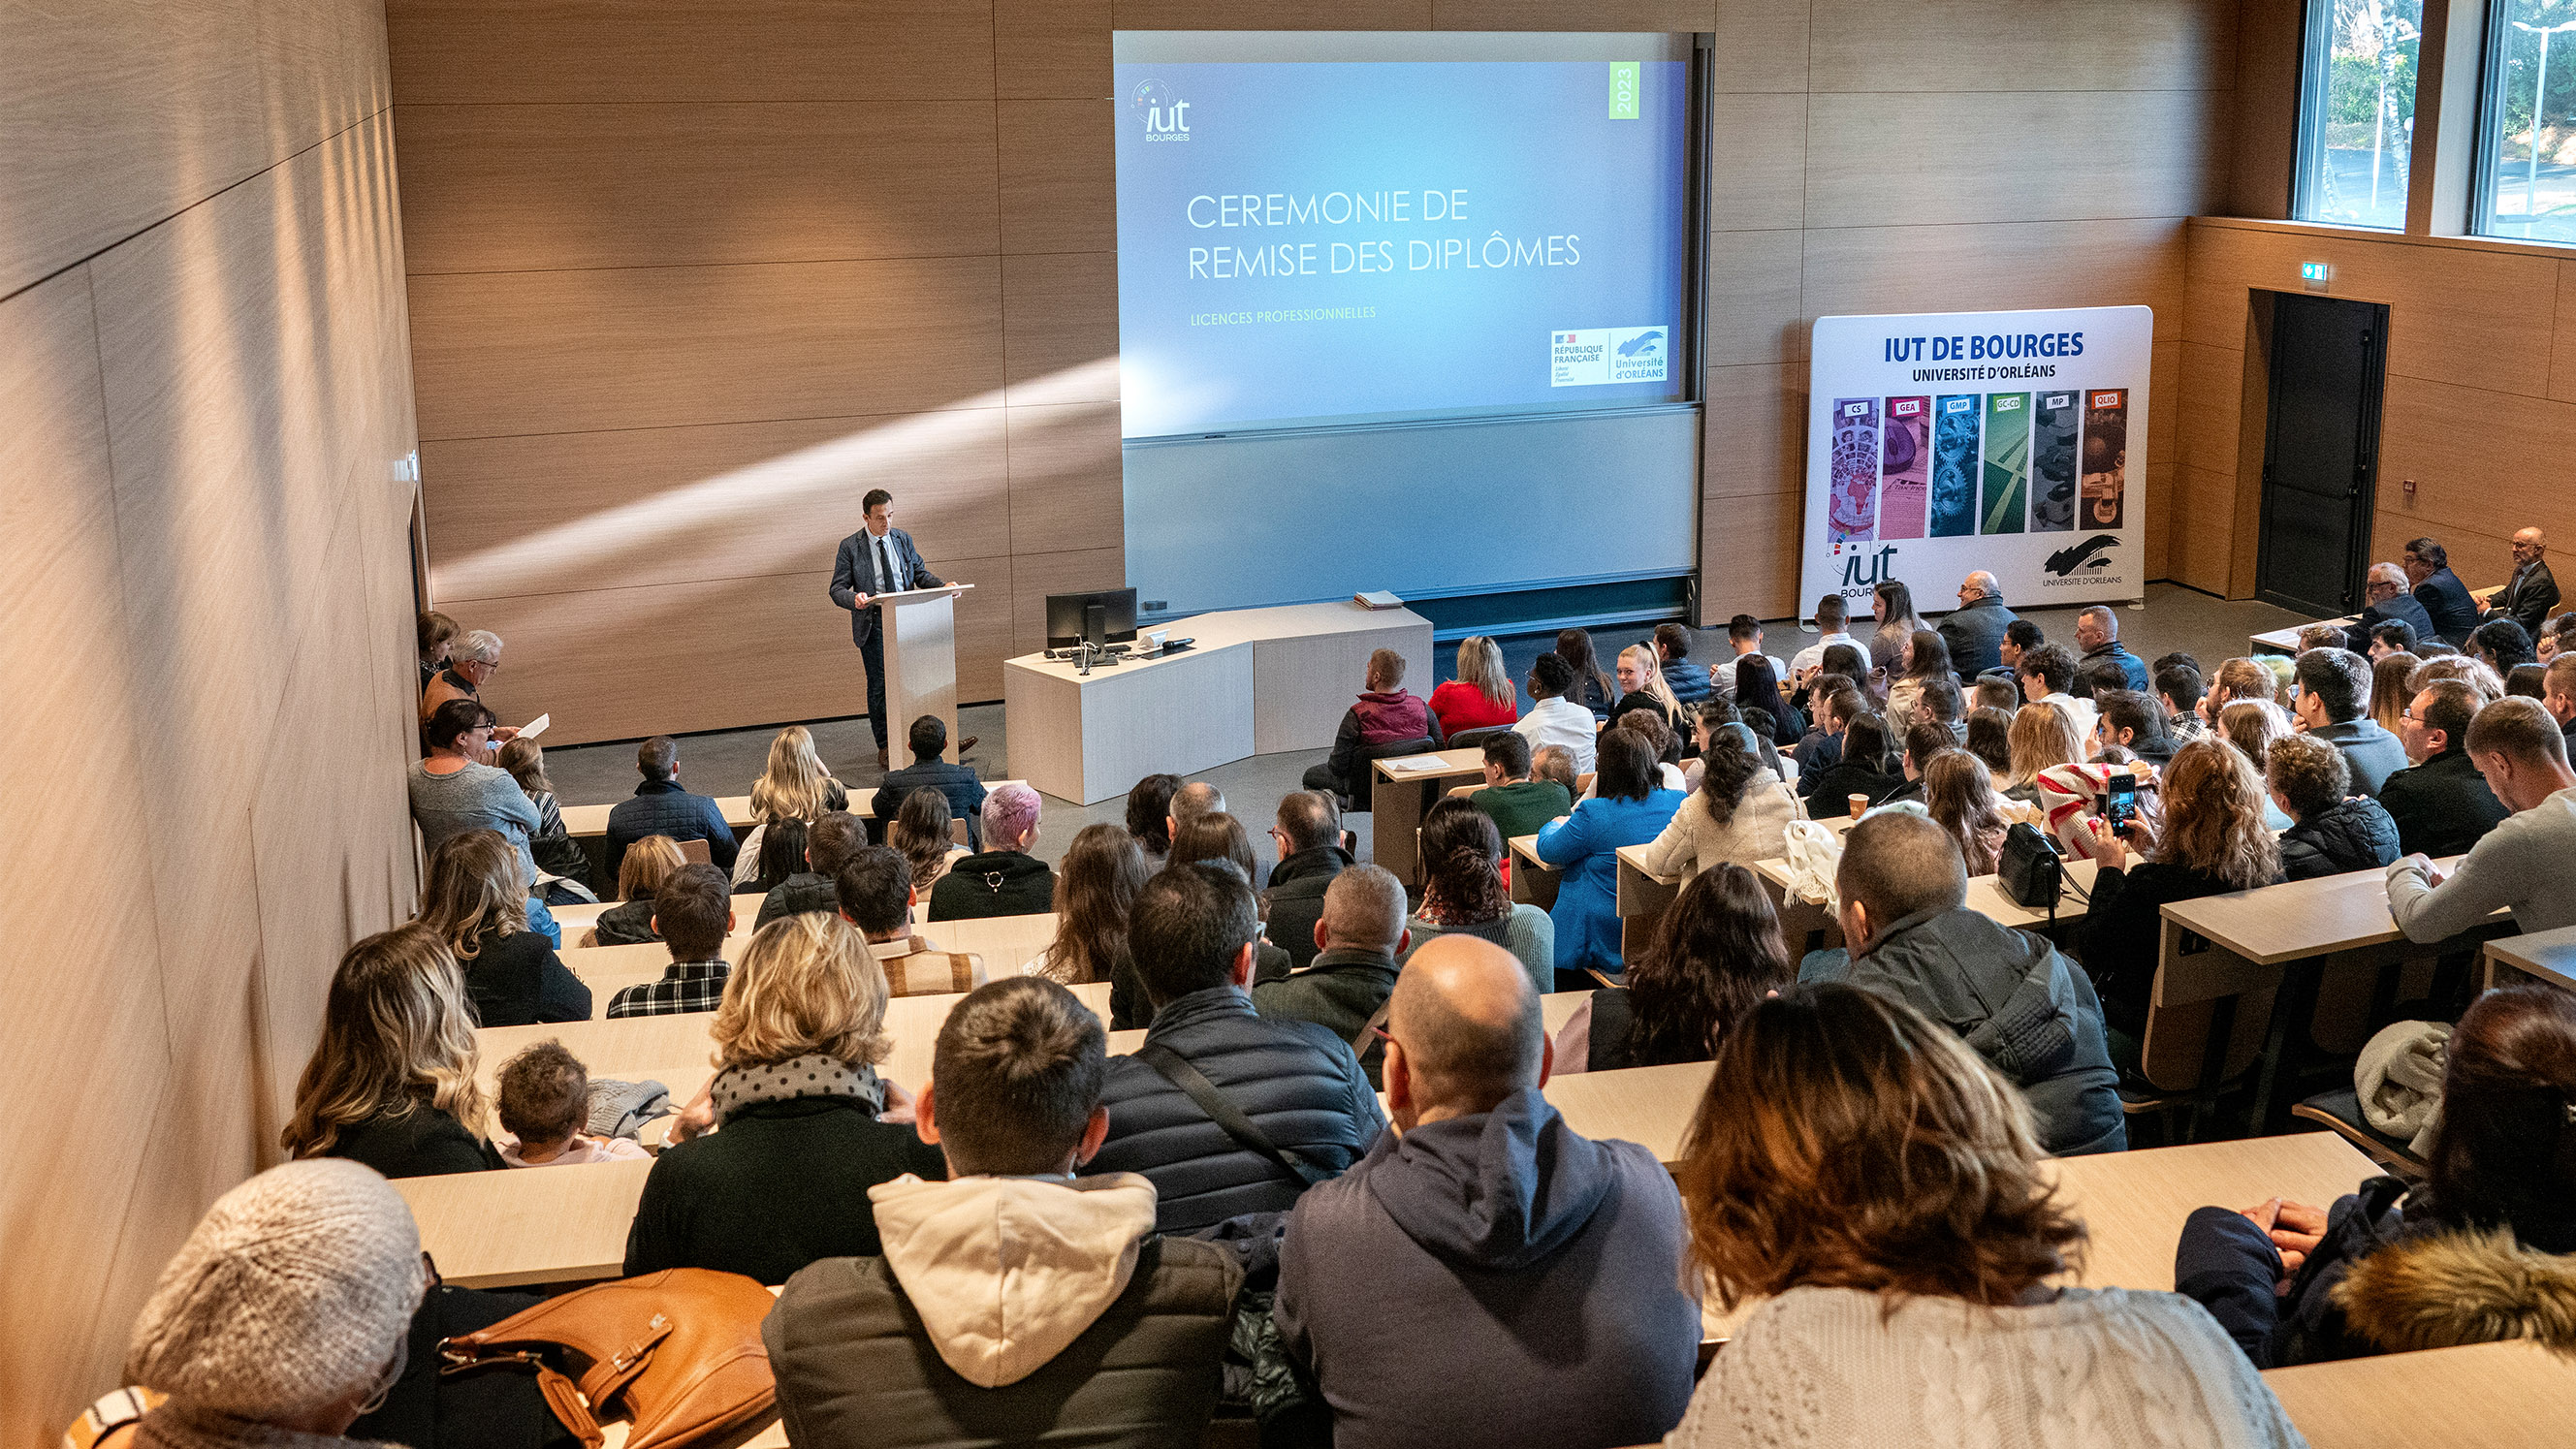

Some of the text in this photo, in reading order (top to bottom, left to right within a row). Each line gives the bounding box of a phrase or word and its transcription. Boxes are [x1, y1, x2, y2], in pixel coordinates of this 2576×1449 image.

[1617, 67, 1632, 113] 2023
[1146, 98, 1191, 133] iut
[1145, 133, 1191, 142] BOURGES
[1187, 189, 1468, 229] CEREMONIE DE
[1189, 230, 1580, 280] REMISE DES DIPLÔMES
[1190, 305, 1377, 327] LICENCES PROFESSIONNELLES
[1554, 344, 1604, 355] RÉPUBLIQUE
[1885, 331, 2084, 362] IUT DE BOURGES
[1554, 354, 1600, 363] FRANÇAISE
[1615, 357, 1664, 368] Université
[1615, 367, 1664, 380] d'ORLÉANS
[1912, 362, 2056, 382] UNIVERSITÉ D'ORLÉANS
[1997, 399, 2019, 408] GC-CD
[2051, 397, 2064, 406] MP
[2097, 395, 2115, 404] QLIO
[1851, 405, 1861, 414] CS
[1899, 403, 1916, 412] GEA
[1950, 401, 1967, 410] GMP
[1842, 544, 1898, 586] iut
[2043, 576, 2122, 587] UNIVERSITE D'ORLEANS
